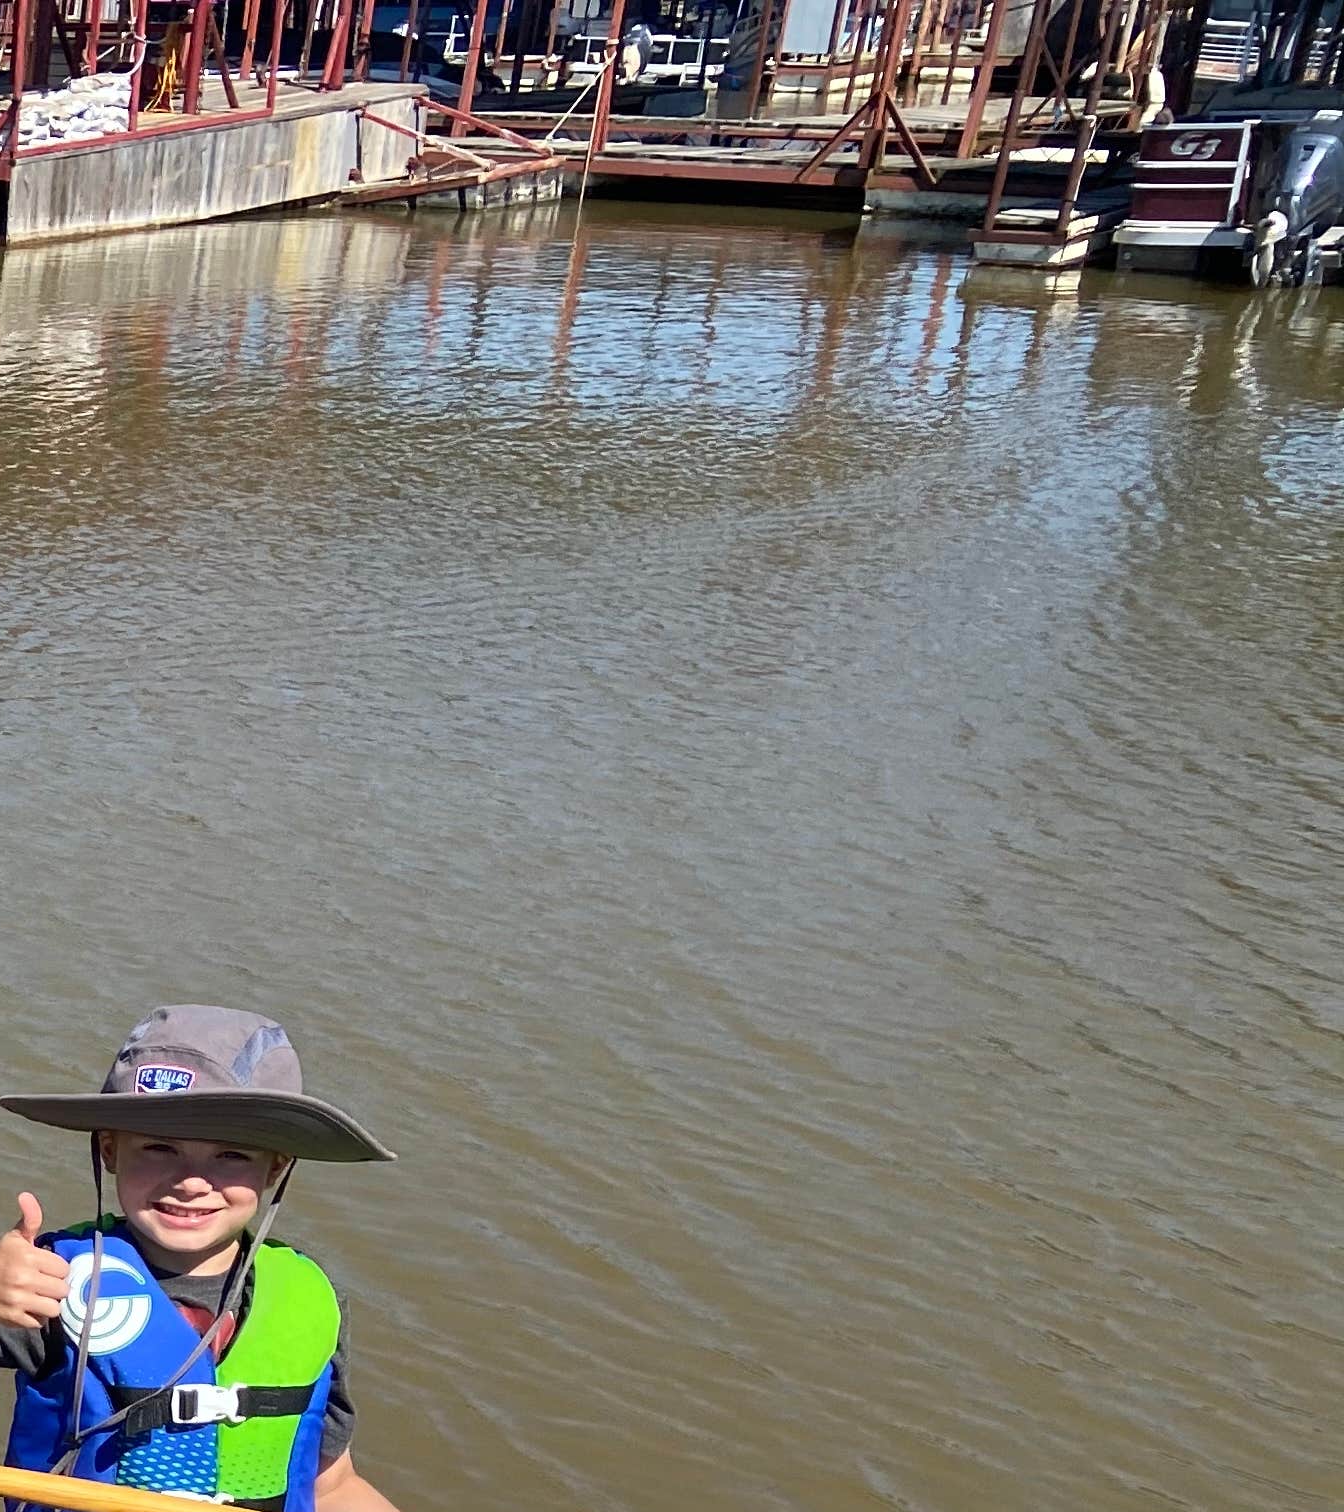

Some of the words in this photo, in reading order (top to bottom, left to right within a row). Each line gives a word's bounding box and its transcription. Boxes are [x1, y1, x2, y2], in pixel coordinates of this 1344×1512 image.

[1171, 130, 1222, 160] G3
[140, 1069, 154, 1082] FC
[154, 1070, 190, 1086] DALLAS
